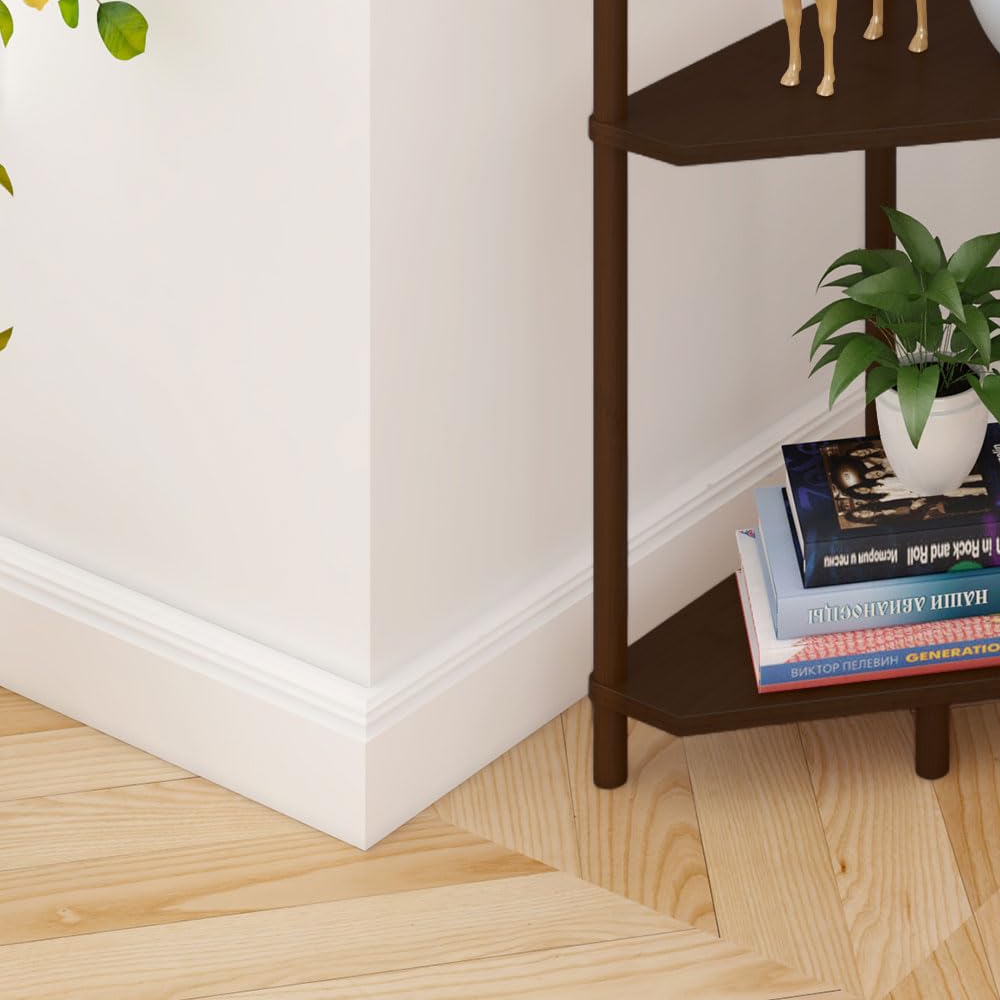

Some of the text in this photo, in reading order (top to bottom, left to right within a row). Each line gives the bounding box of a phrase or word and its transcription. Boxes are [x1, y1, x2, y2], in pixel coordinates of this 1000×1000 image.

[906, 543, 928, 566] Roll
[930, 541, 951, 562] and
[953, 539, 980, 560] Rock
[982, 536, 992, 556] in
[823, 547, 898, 568] История и песни
[807, 589, 988, 625] НАШИ АВИАНОСЦЫ
[791, 655, 899, 678] ВИКТОР ПЕЛЕВИН
